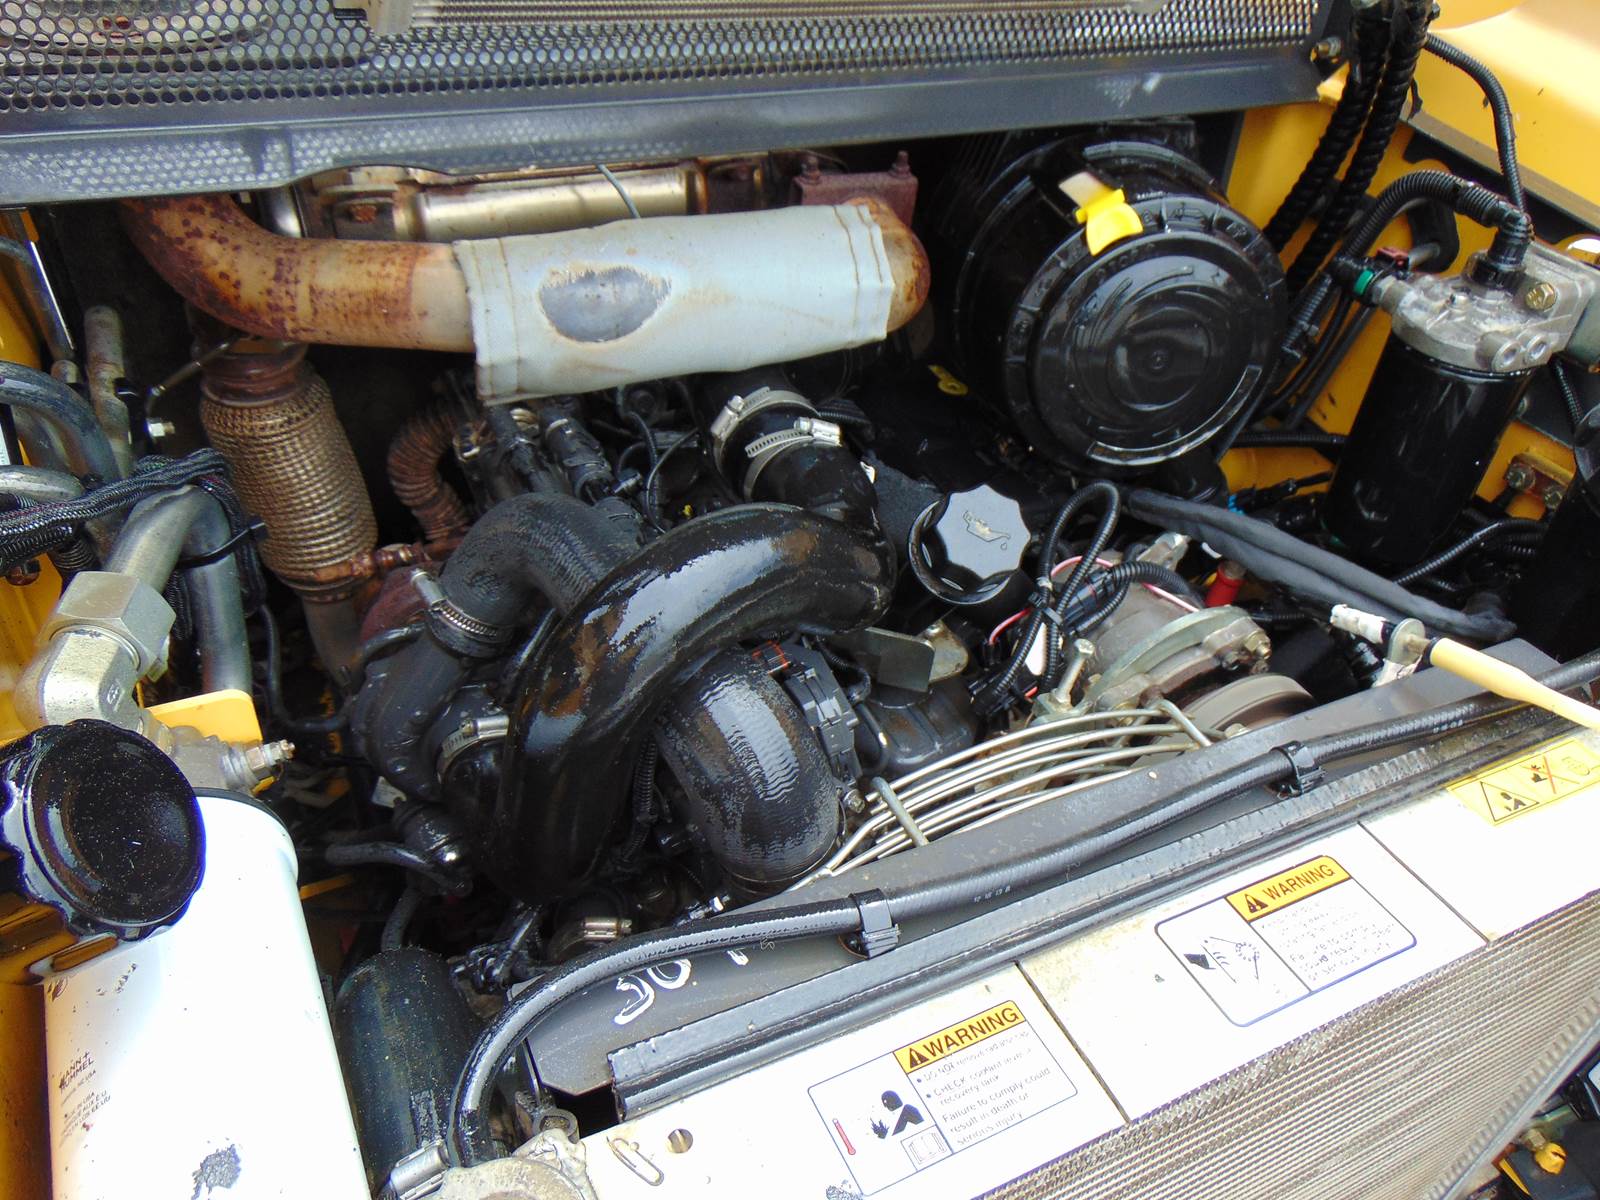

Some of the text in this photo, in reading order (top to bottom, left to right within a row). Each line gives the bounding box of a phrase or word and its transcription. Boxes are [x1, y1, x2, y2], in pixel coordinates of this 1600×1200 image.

[1262, 864, 1335, 901] WARNING
[922, 1007, 1019, 1057] WARNING
[932, 1075, 967, 1096] CHECK
[941, 1067, 1051, 1123] Failure to comply could
[949, 1115, 978, 1134] result
[978, 1110, 990, 1120] in
[989, 1096, 1018, 1115] death
